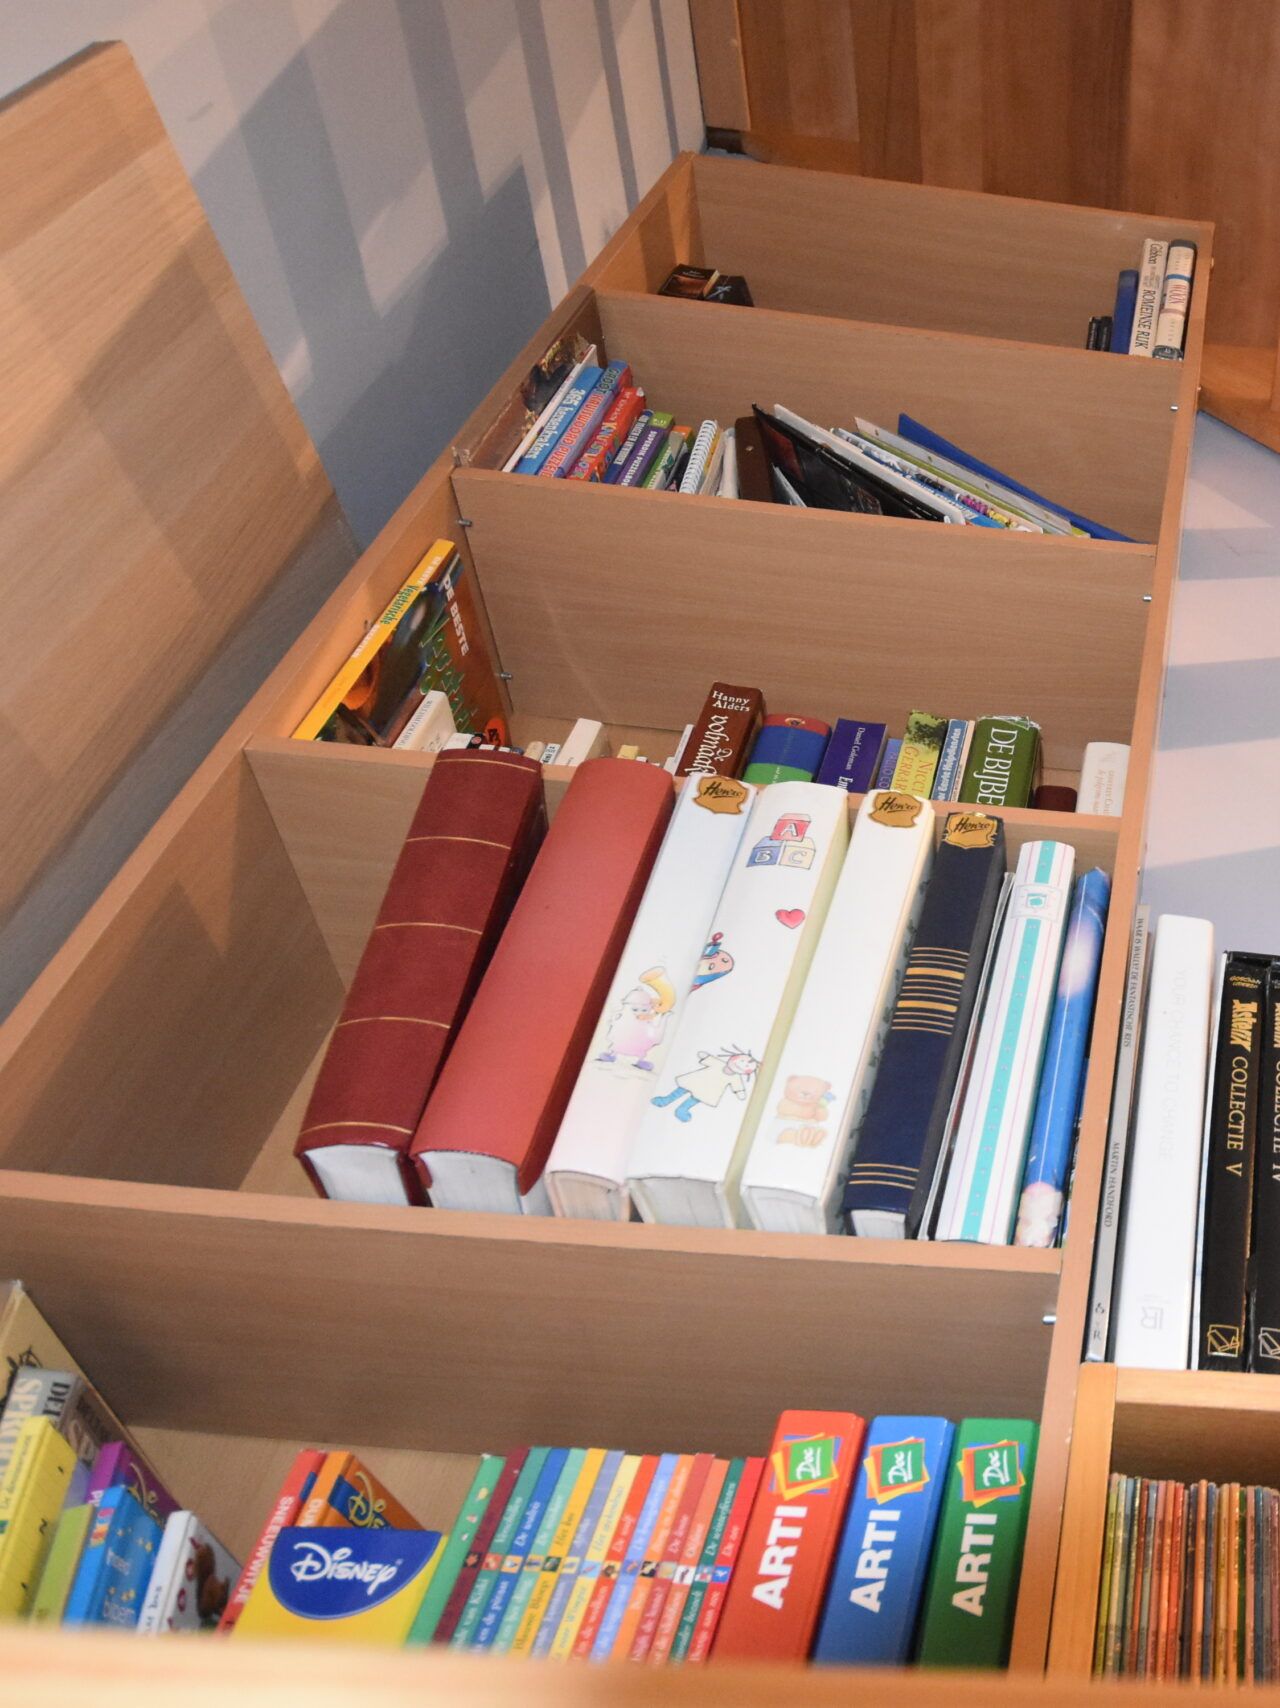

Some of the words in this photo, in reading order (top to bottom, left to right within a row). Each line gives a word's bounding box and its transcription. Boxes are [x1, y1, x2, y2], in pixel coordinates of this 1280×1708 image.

[1137, 289, 1156, 330] ROMEINSE
[1134, 330, 1151, 349] RIJK
[562, 387, 586, 406] 365
[443, 573, 456, 602] DE
[450, 601, 470, 656] BESTE
[712, 690, 750, 705] Hanny
[712, 700, 751, 712] Alders
[684, 714, 729, 777] volmaak
[854, 727, 866, 747] Daniel
[986, 727, 1018, 756] DE
[780, 822, 799, 837] A
[755, 849, 772, 863] B
[1230, 999, 1258, 1053] Asterix
[1227, 1056, 1249, 1150] COLLECTIE
[1110, 1142, 1120, 1174] MARTIN
[1225, 1162, 1244, 1177] V
[1104, 1176, 1115, 1228] HANDFORD
[233, 1496, 296, 1605] SNEEUWWITJE
[704, 1541, 716, 1557] De
[752, 1505, 808, 1610] ARTI
[849, 1510, 901, 1613] ARTI
[952, 1513, 998, 1617] ARTI
[290, 1542, 399, 1597] Disney
